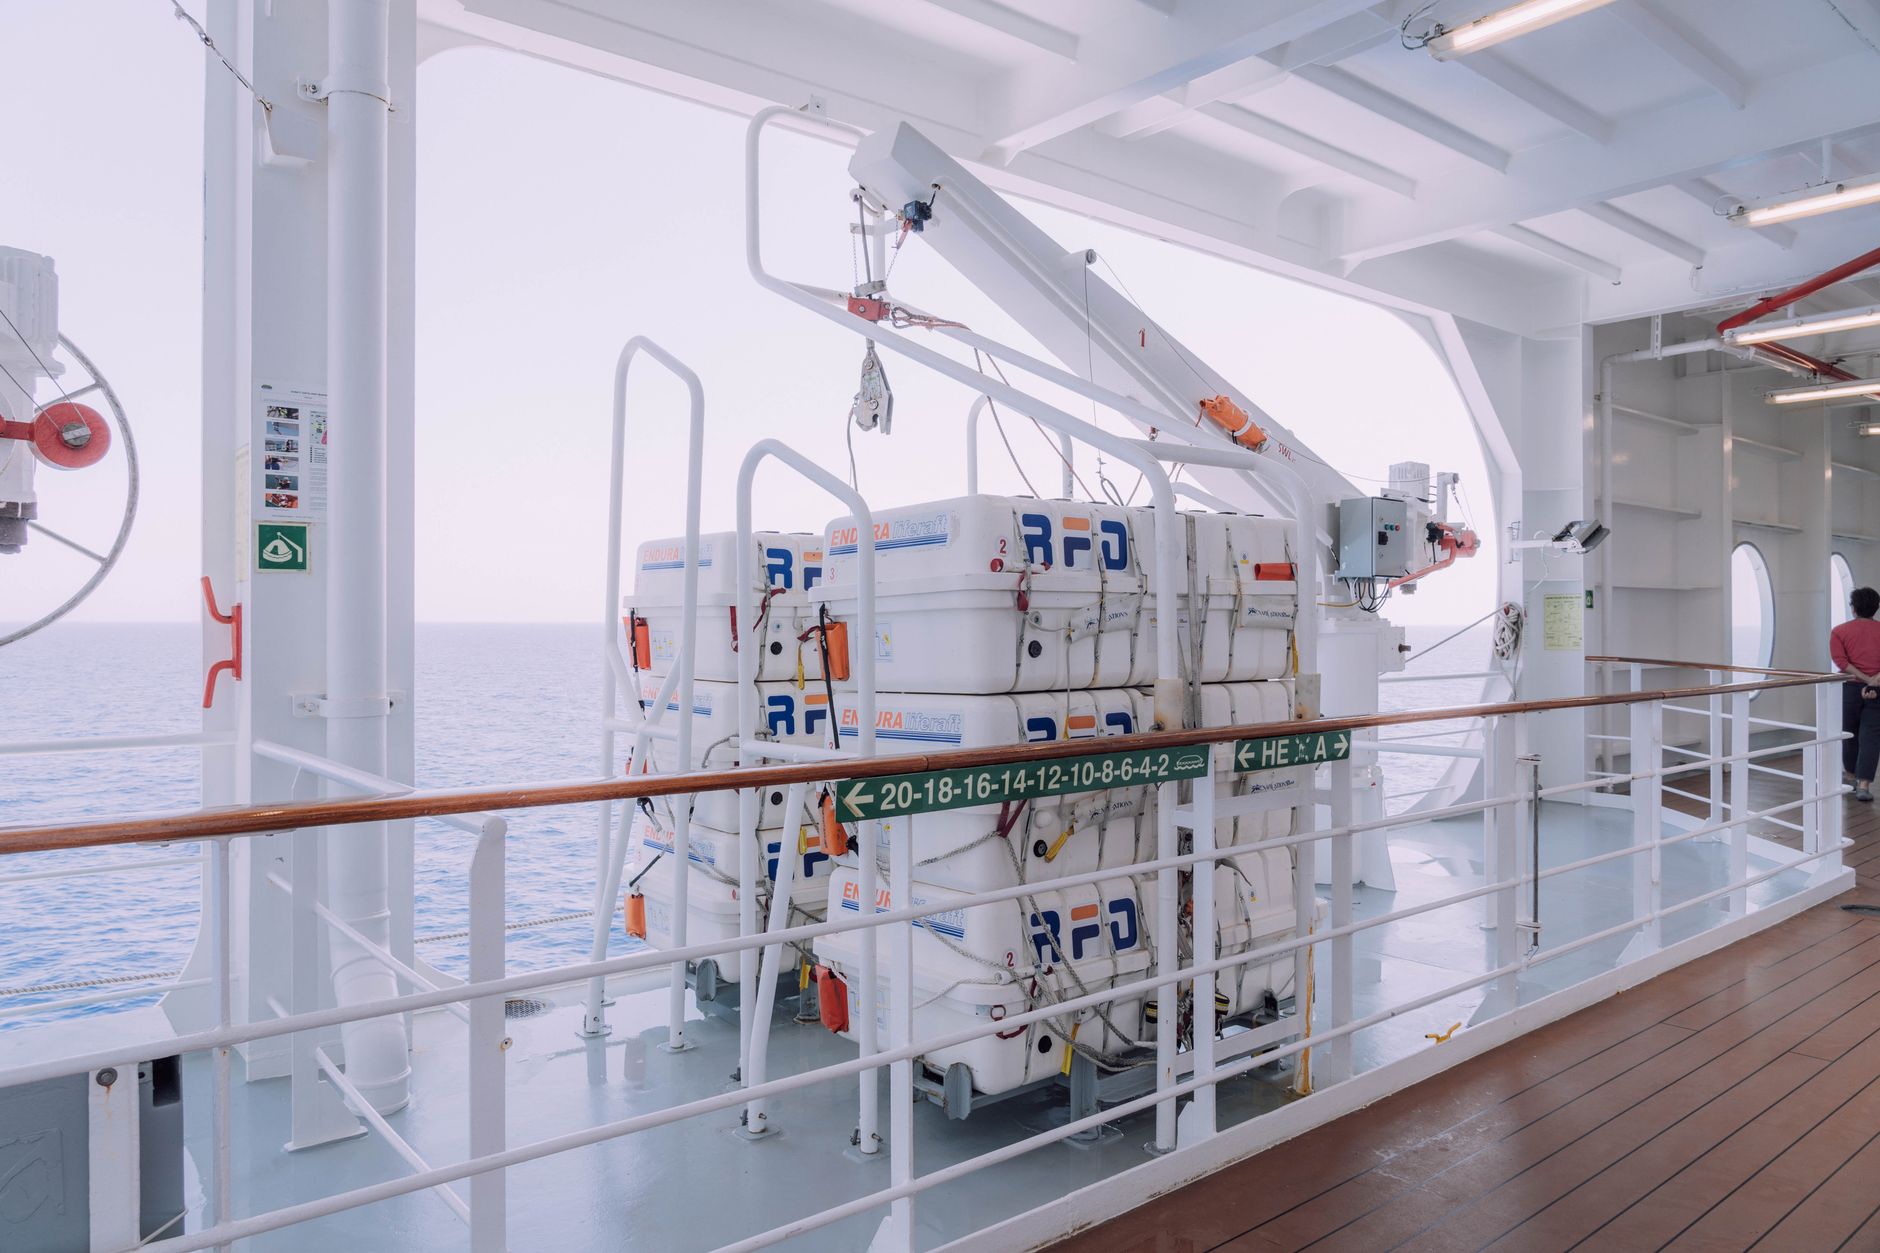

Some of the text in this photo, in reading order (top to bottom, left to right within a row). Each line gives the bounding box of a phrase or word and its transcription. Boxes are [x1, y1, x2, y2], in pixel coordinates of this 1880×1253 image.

[831, 522, 890, 547] ENDRA
[999, 538, 1007, 554] 2
[1022, 513, 1128, 570] RFD
[841, 708, 904, 730] ENURA
[880, 754, 1170, 811] 20-18-16-14-12-10-8-6-4-2
[1030, 898, 1138, 963] RFD
[1006, 952, 1015, 968] 2
